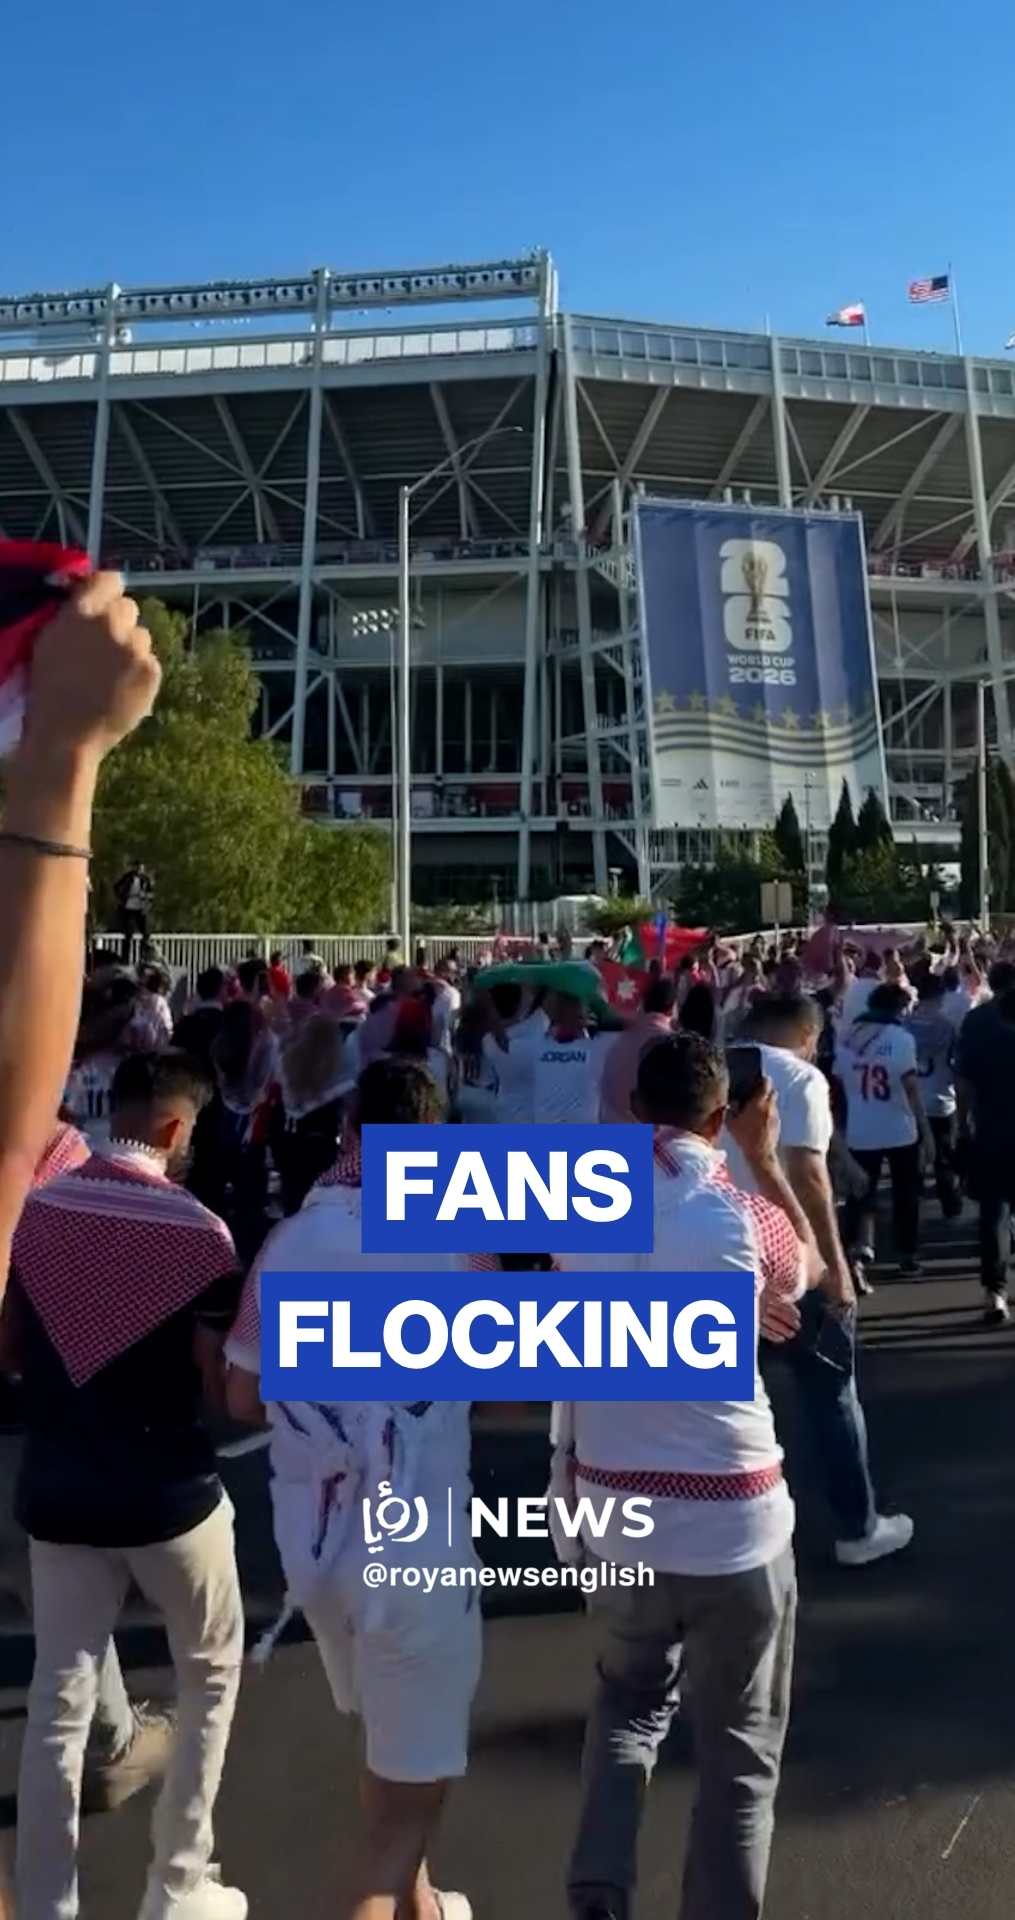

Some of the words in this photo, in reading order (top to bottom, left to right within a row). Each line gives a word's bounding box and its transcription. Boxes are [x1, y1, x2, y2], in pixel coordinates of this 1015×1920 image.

[745, 628, 776, 640] FIFA
[727, 654, 771, 667] WORLD
[772, 656, 796, 668] CUP
[729, 667, 797, 686] 2026
[540, 1051, 587, 1063] JORDAN
